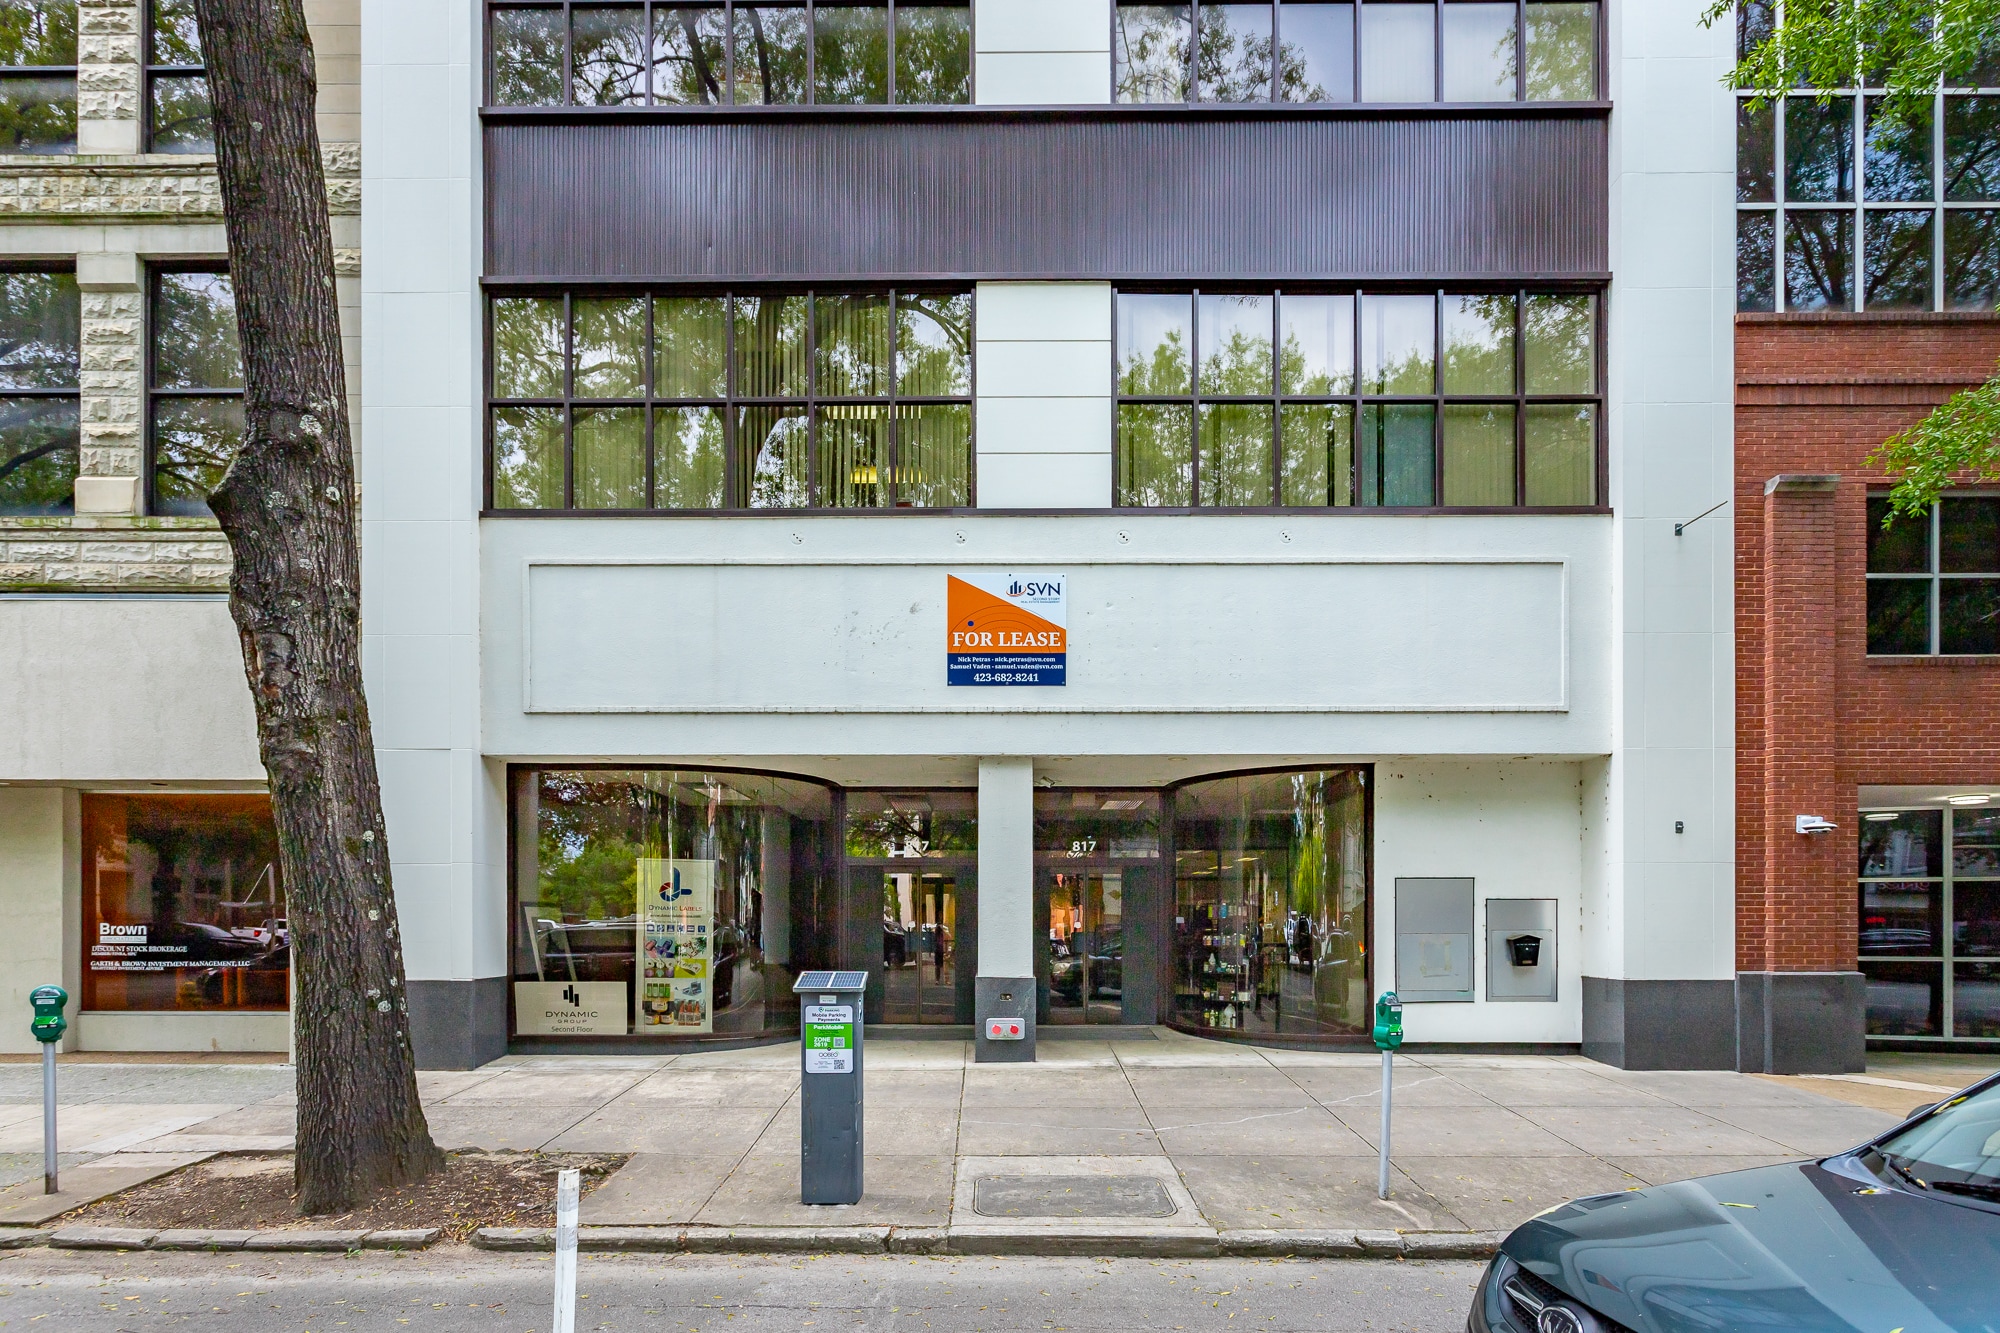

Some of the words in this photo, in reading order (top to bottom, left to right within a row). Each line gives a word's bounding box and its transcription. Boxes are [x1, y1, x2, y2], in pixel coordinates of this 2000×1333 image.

[1026, 582, 1061, 596] SVN
[952, 632, 993, 647] FOR
[998, 632, 1061, 647] LEASE
[994, 656, 1056, 664] nick.petras@svn.com
[994, 663, 1064, 671] samuel.vaden@svn.com
[973, 672, 1039, 683] 423-682-8241
[1072, 840, 1097, 852] 817
[99, 922, 147, 935] Brown
[149, 945, 188, 953] BROKERAGE
[189, 960, 237, 968] MANAGEMENT,
